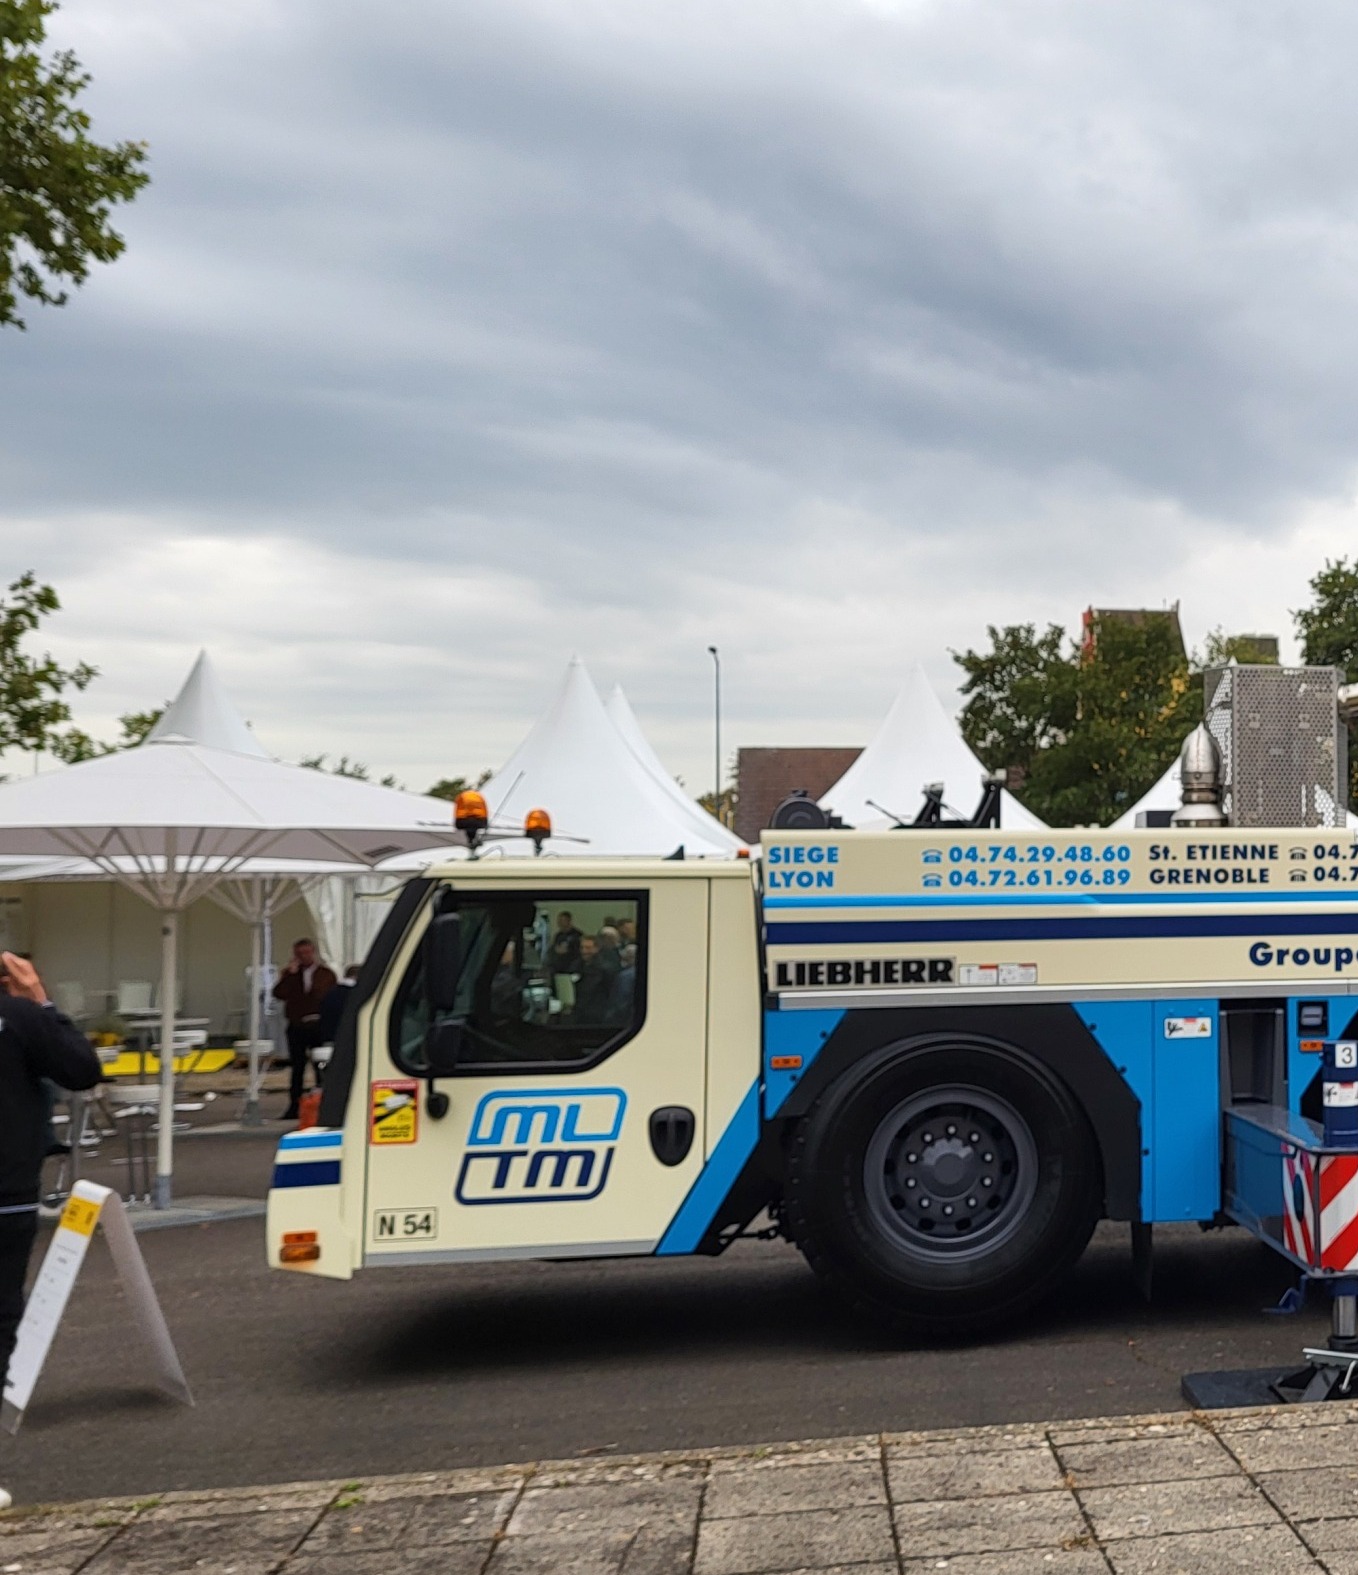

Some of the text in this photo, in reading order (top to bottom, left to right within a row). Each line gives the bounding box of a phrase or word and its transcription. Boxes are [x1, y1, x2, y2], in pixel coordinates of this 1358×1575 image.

[768, 845, 1131, 864] SIEGE 04.74.29.48.60
[1149, 844, 1177, 861] St.
[1187, 844, 1279, 861] ETIENNE
[768, 868, 1131, 888] LYON 04.72.61.96.89
[1149, 867, 1270, 885] GRENOBLE
[776, 959, 954, 986] LIEBHERR
[1341, 1046, 1353, 1064] 3
[379, 1213, 431, 1235] N 54
